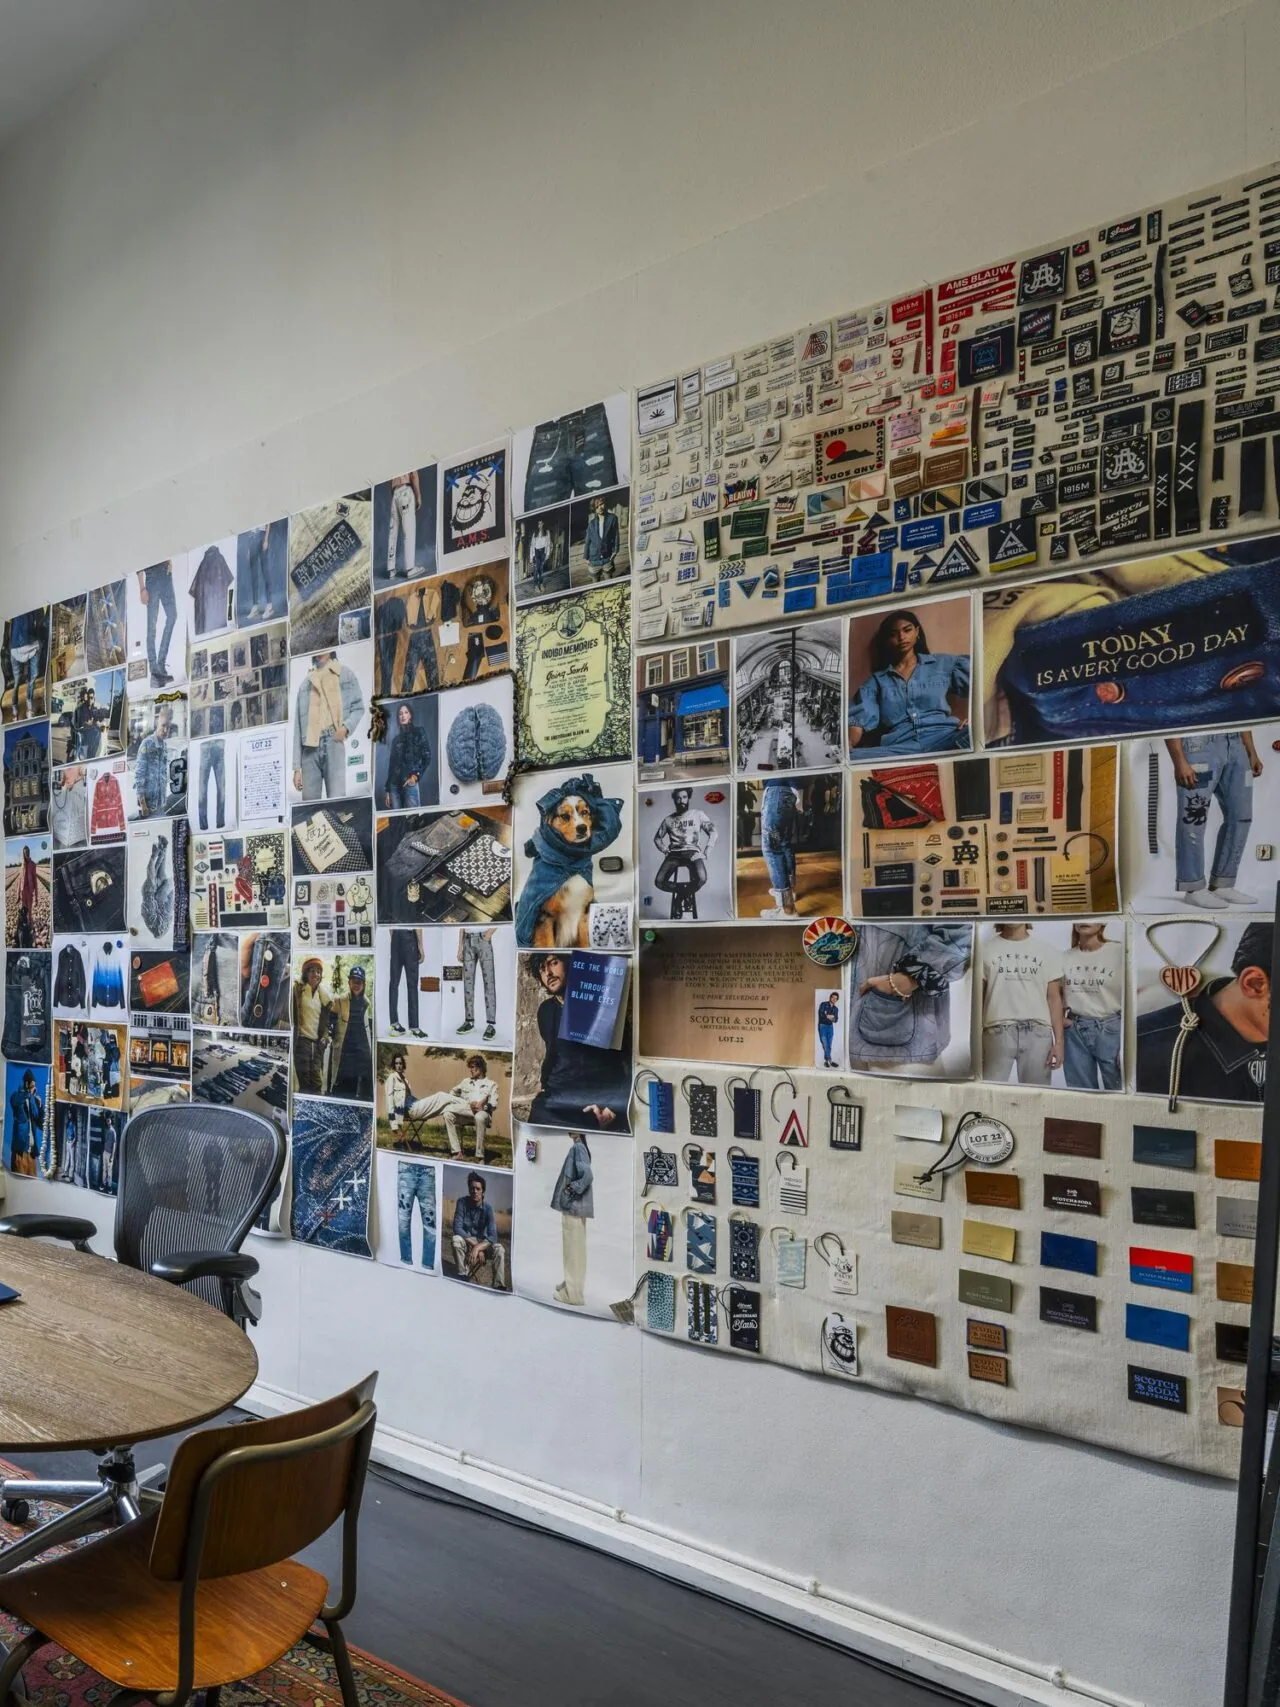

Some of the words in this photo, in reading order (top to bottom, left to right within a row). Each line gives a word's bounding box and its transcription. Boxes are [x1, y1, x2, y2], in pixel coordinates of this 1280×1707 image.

[946, 278, 969, 292] AMS
[970, 264, 1011, 283] BLAUW
[1023, 315, 1051, 332] BLAUW
[1038, 345, 1059, 356] LUCKY
[1155, 351, 1172, 360] LUCKY
[823, 429, 845, 438] AND
[849, 421, 876, 432] SODA
[824, 470, 850, 481] SODA
[855, 466, 875, 475] AND
[692, 491, 717, 508] BLAUW
[729, 489, 752, 502] BLAUW
[1105, 500, 1143, 521] SCOTCH
[300, 531, 345, 588] BLAUWER
[542, 647, 563, 659] INDIGO
[563, 638, 598, 654] MEMORIES
[1082, 623, 1173, 659] TODAY
[1037, 670, 1053, 686] IS
[1058, 667, 1070, 681] A
[1070, 656, 1124, 679] VERY
[1126, 642, 1195, 670] GOOD
[1203, 624, 1249, 652] DAY
[252, 742, 263, 750] LOT
[573, 961, 585, 969] SEE
[589, 963, 600, 972] THE
[604, 966, 624, 976] WORLD
[998, 966, 1038, 975] BLAUW
[1162, 967, 1197, 993] ELVIS
[571, 990, 595, 1002] BLAUW
[598, 995, 616, 1005] EYES
[689, 1015, 730, 1025] SCOTCH
[733, 1017, 741, 1025] &
[745, 1017, 774, 1026] SODA
[969, 1135, 988, 1143] LOT
[965, 1147, 974, 1156] THE
[1134, 1374, 1179, 1390] SCOTCH
[1134, 1390, 1180, 1403] AMSTERDAM
[1147, 1384, 1180, 1398] SODA
